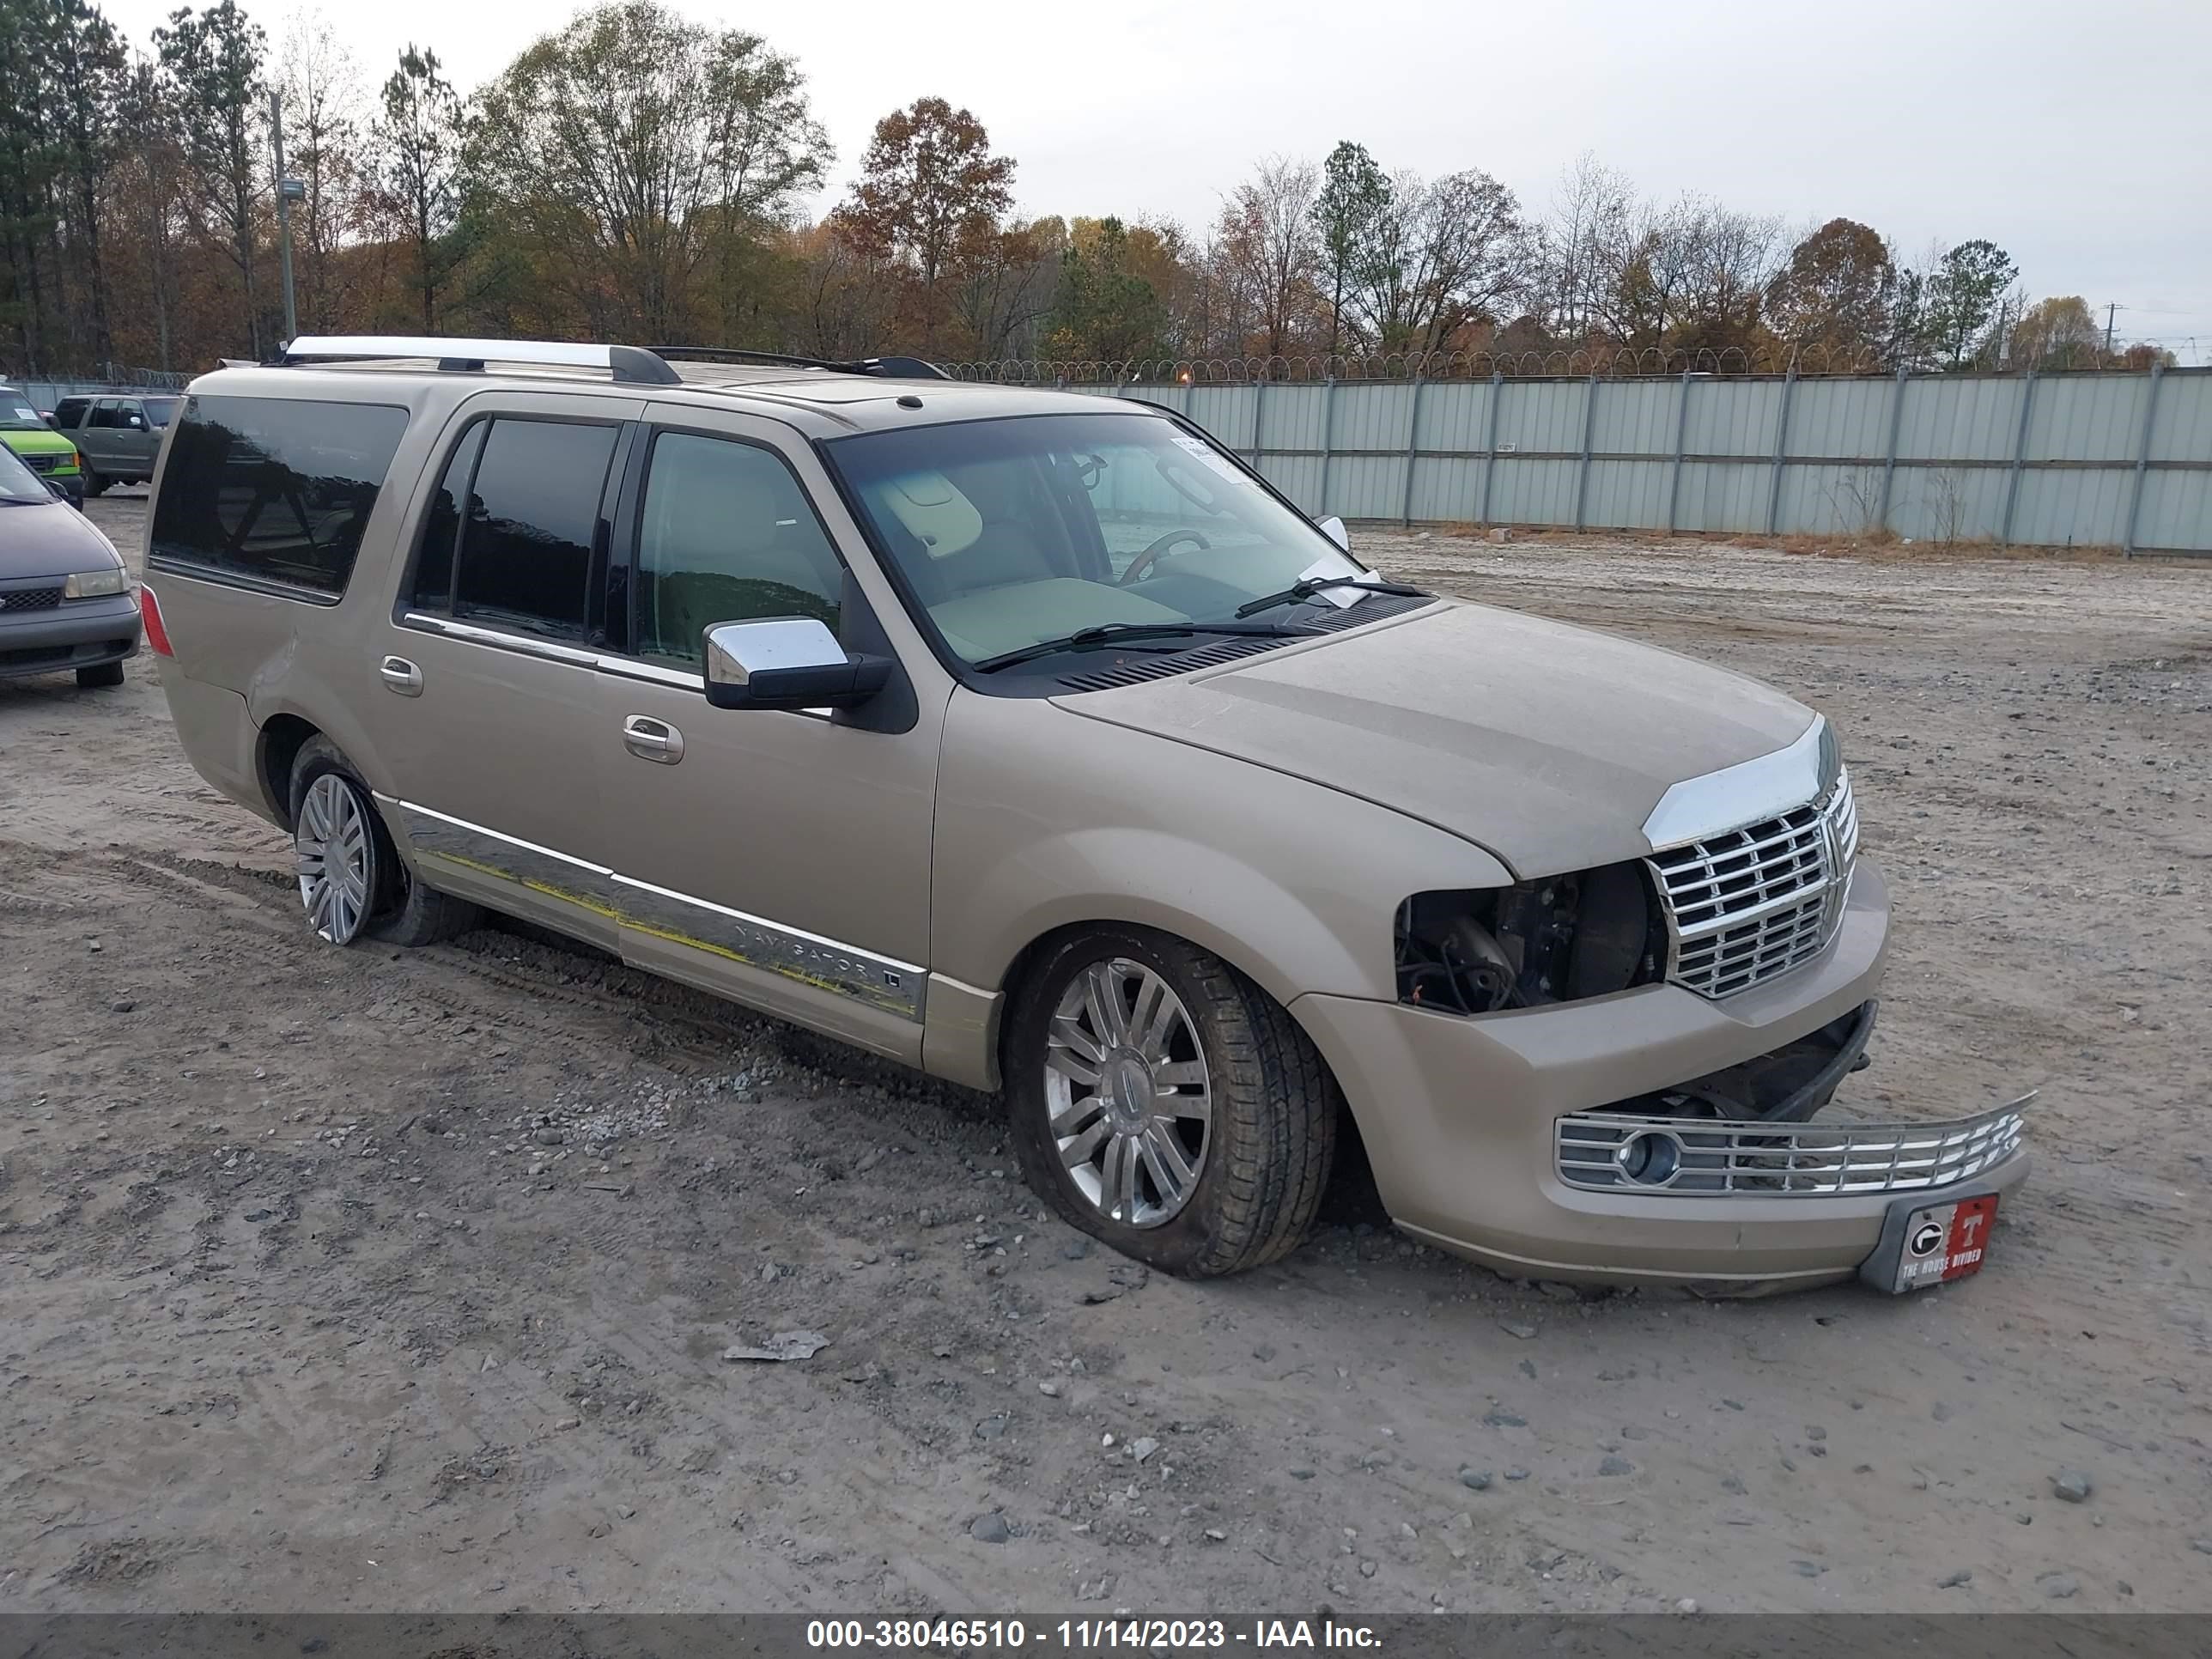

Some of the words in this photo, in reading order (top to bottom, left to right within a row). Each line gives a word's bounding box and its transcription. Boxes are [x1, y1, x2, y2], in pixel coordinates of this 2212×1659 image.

[1963, 1214, 1984, 1247] T
[1903, 1263, 1918, 1279] THE
[1922, 1257, 1949, 1274] HOUSE
[1952, 1249, 1982, 1267] DIVIDED
